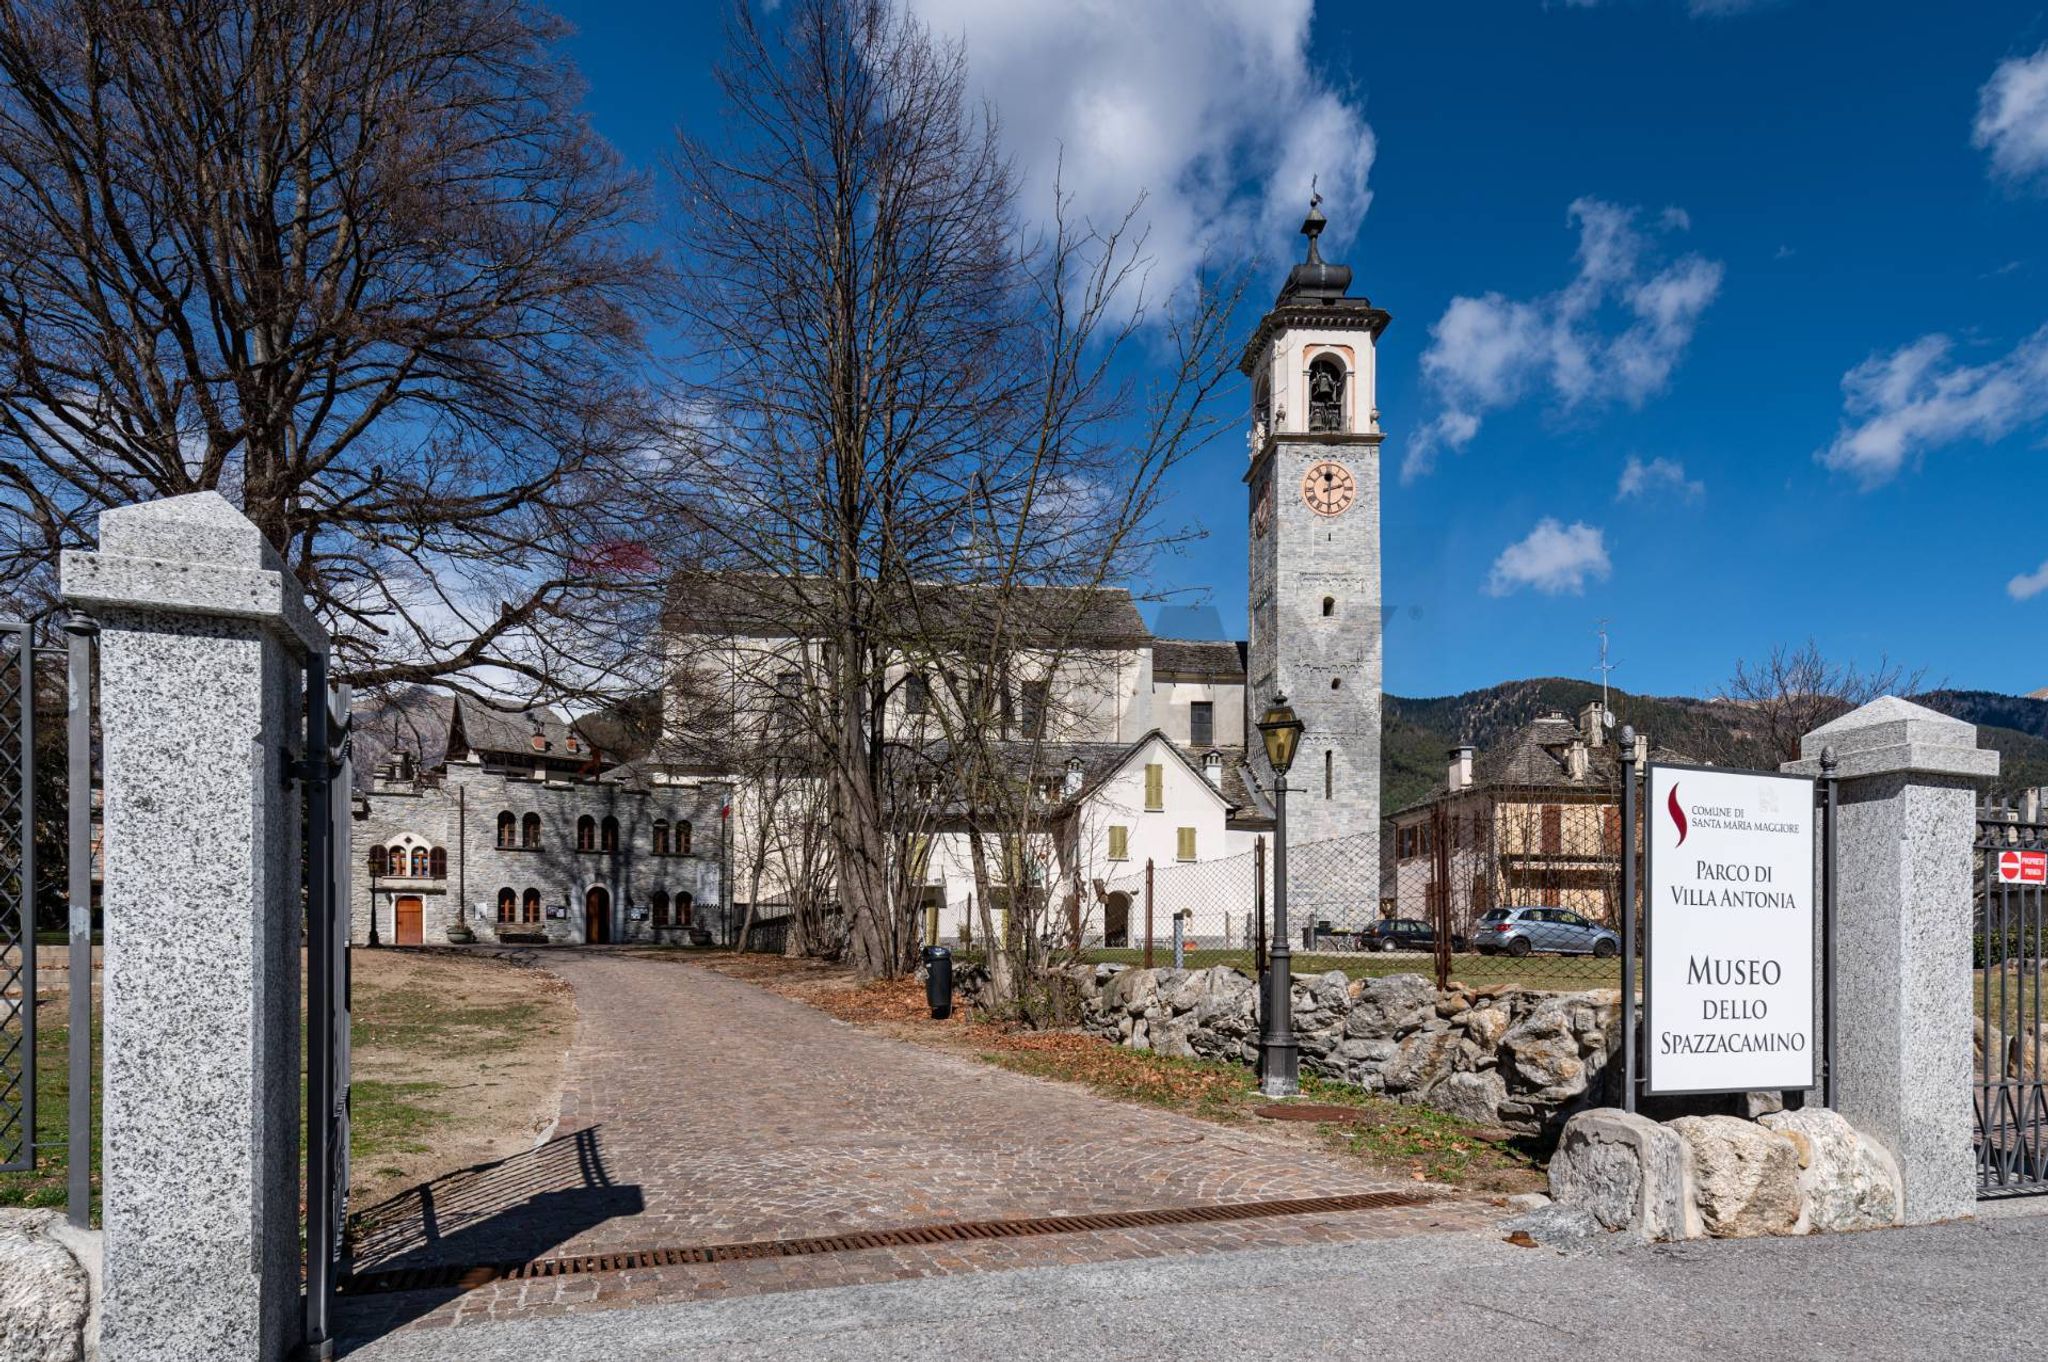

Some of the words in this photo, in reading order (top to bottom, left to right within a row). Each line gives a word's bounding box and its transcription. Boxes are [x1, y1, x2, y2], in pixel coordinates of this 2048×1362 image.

[1691, 805, 1732, 818] COMUNE
[1734, 808, 1744, 818] DI
[1691, 817, 1721, 829] SANTA
[1723, 820, 1752, 831] MARIA
[1754, 822, 1799, 834] MAGGIORE
[1696, 860, 1750, 882] PARCO
[1754, 865, 1772, 883] DI
[1670, 885, 1718, 907] VILLA
[1719, 888, 1796, 909] ANTONIA
[1686, 954, 1782, 986] MUSEO
[1702, 999, 1768, 1020] DELLO
[1660, 1031, 1806, 1055] SPAZZACAMINO
